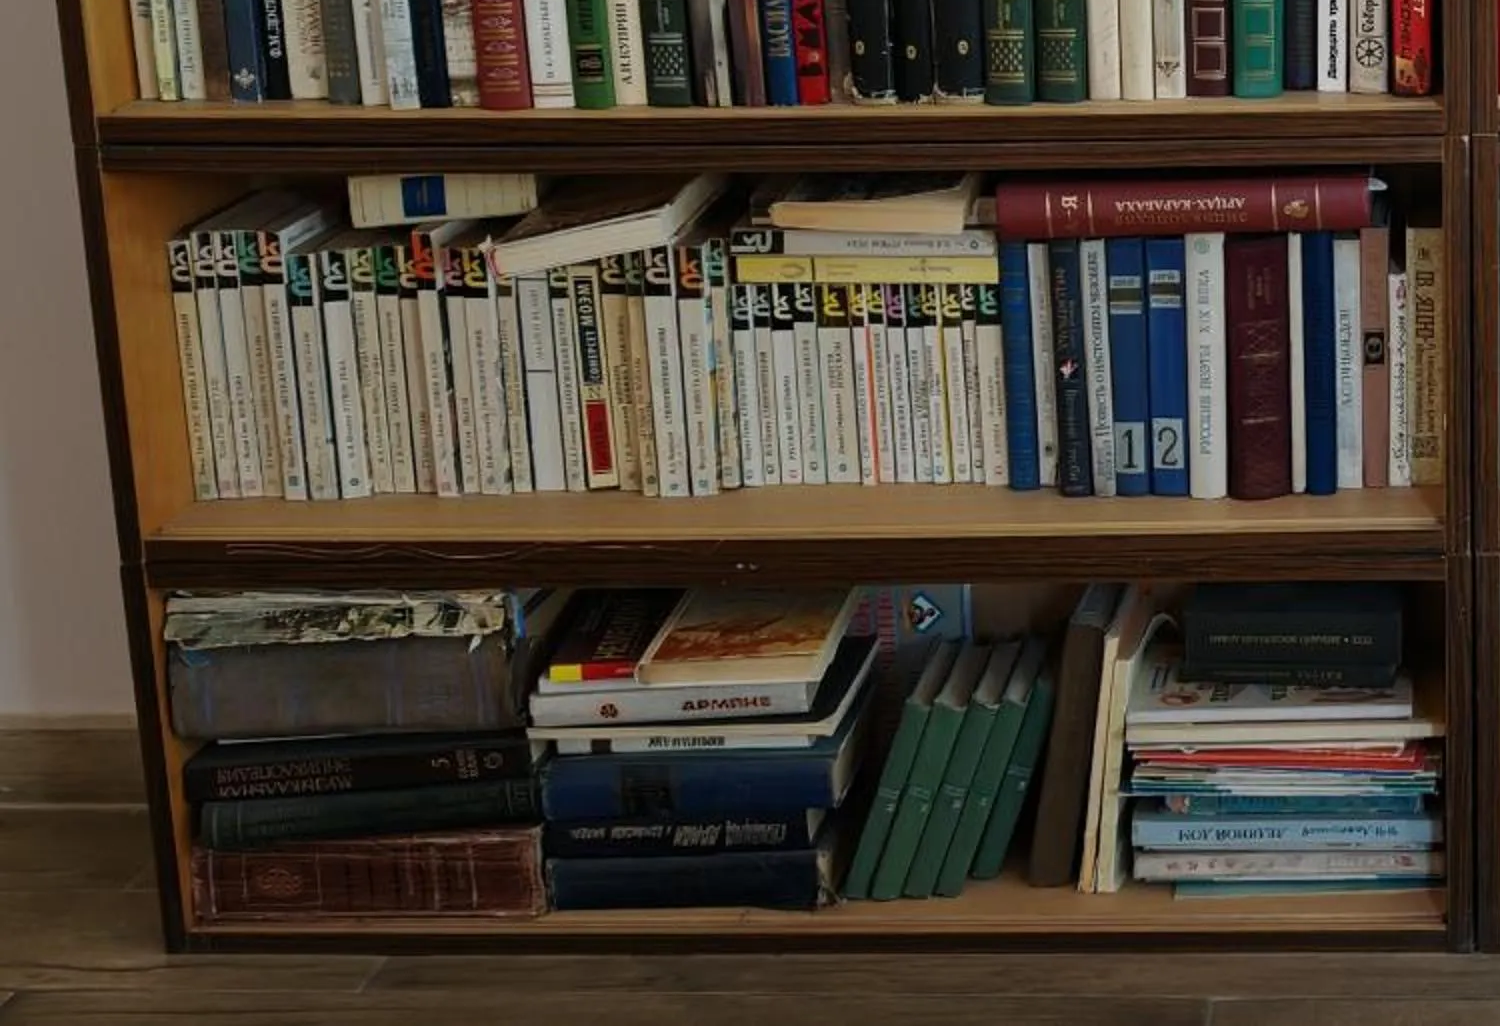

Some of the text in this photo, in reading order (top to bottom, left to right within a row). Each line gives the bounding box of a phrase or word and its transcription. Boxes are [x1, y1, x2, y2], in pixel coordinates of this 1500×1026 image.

[574, 282, 595, 327] МОЭМ
[1121, 428, 1138, 471] 1
[1157, 425, 1179, 466] 2
[681, 695, 772, 712] АРМЯНЕ
[1178, 827, 1213, 844] ДОМ
